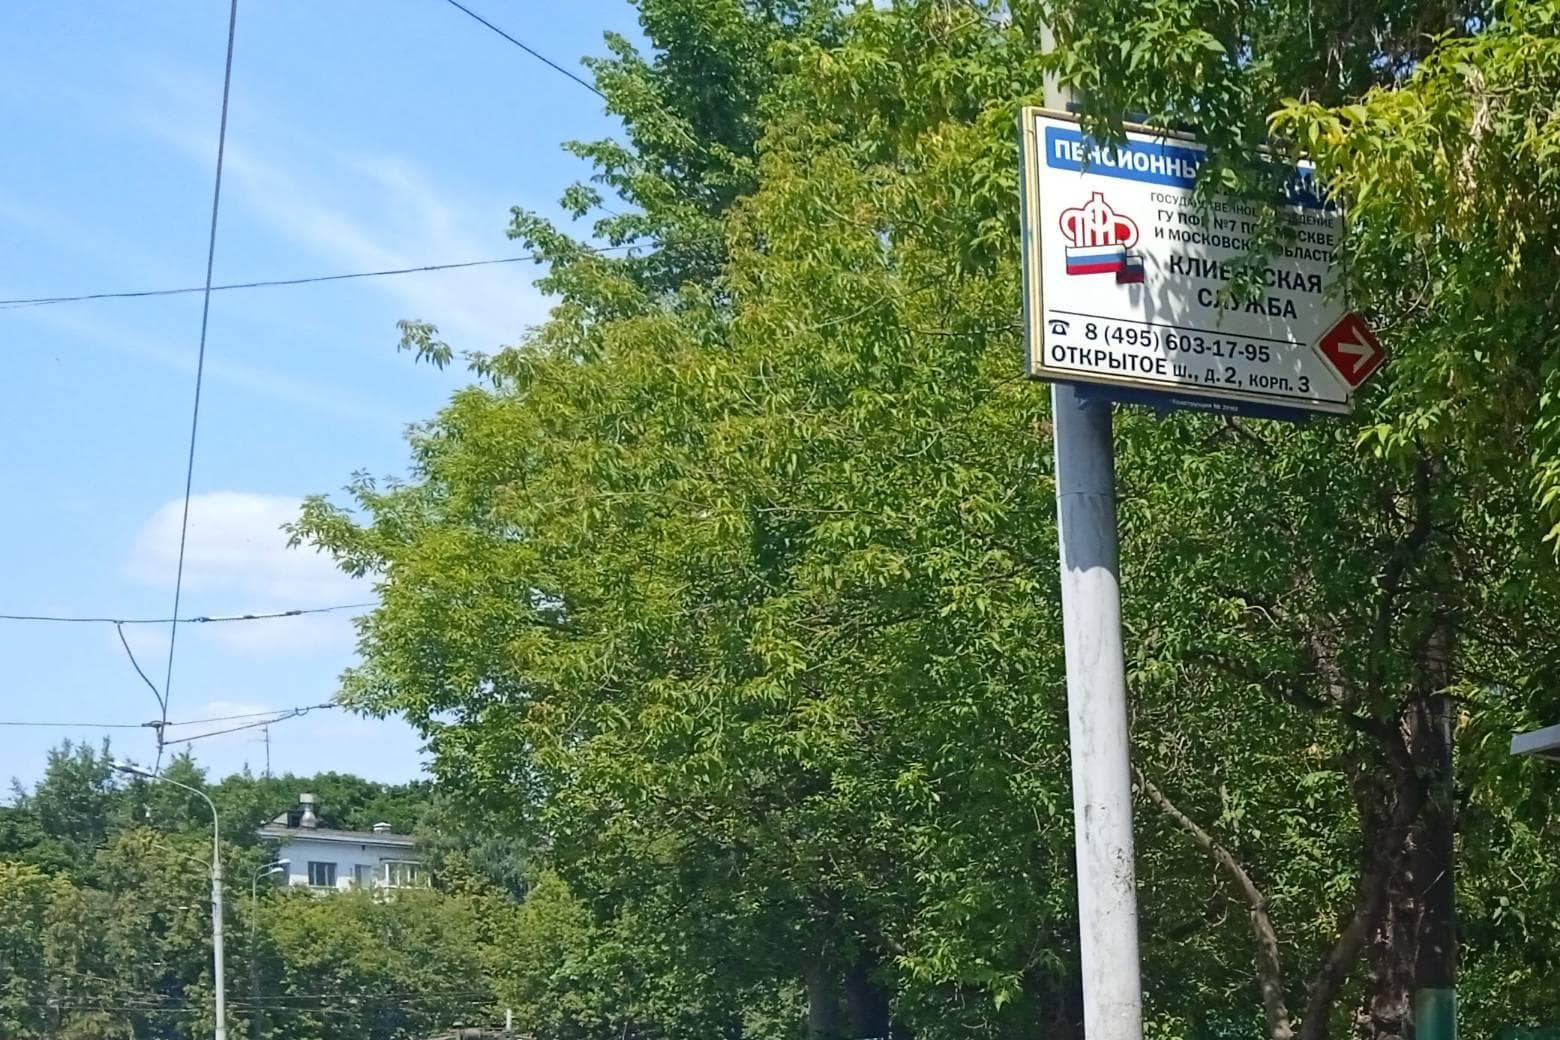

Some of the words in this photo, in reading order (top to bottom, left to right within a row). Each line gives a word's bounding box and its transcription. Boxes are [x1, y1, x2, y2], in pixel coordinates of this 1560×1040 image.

[1158, 209, 1174, 222] ГУ
[1154, 226, 1164, 239] И
[1168, 228, 1260, 251] МОСКОВСК
[1085, 322, 1098, 341] 8
[1104, 325, 1160, 353] (495)
[1165, 333, 1271, 363] 603-17-95
[1051, 344, 1168, 375] ОТКРЫТОЕ
[1224, 366, 1243, 388] 2,
[1298, 375, 1311, 393] 3
